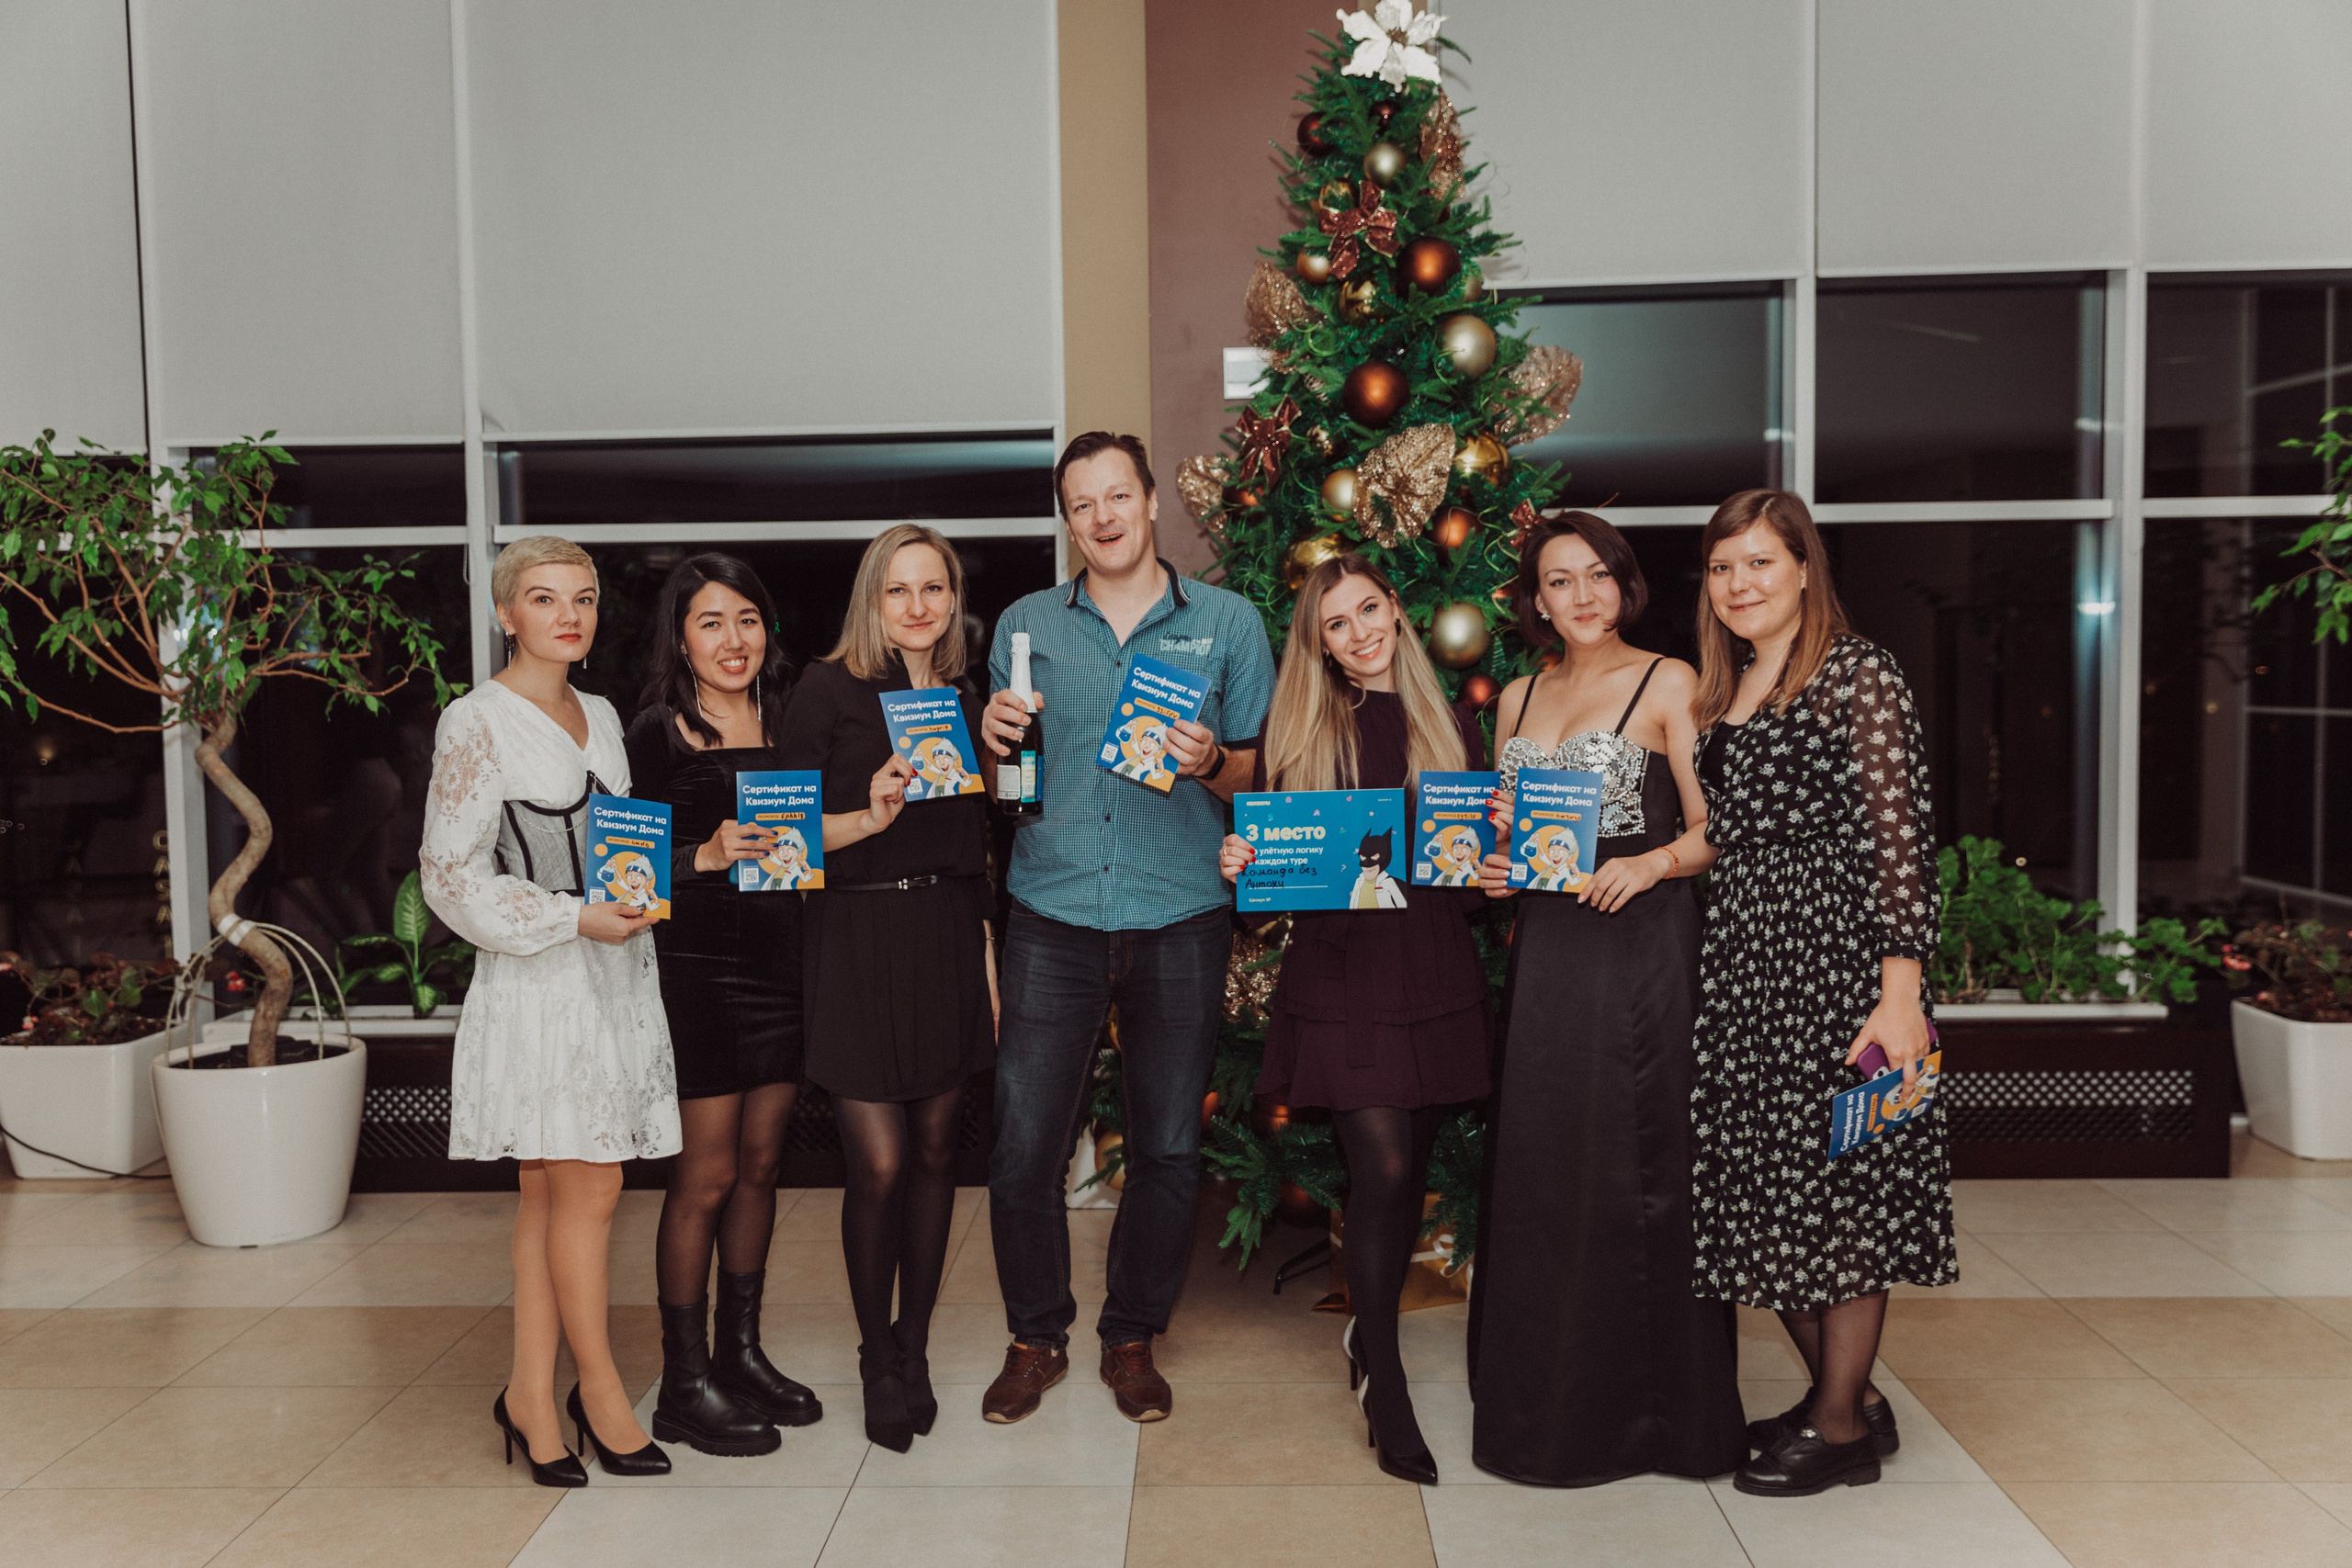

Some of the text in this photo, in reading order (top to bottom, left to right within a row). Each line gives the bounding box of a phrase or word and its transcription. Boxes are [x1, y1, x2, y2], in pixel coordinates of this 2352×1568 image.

[1133, 667, 1202, 699] Сертификат на
[1131, 678, 1194, 709] Квизиум Дома
[888, 700, 943, 712] Сертификат
[893, 710, 956, 723] Квизиум Дома
[742, 784, 802, 795] Сертификат
[1423, 784, 1481, 795] Сертификат
[1521, 780, 1582, 794] Сертификат
[745, 796, 814, 807] Квизиум Дома
[1425, 795, 1487, 807] Квизиум Дом
[1522, 793, 1593, 807] Квизиум Дома
[594, 807, 667, 825] Сертификат на
[596, 818, 664, 836] Квизиум Дома
[1246, 824, 1326, 841] 3 место
[1260, 847, 1295, 856] улётную
[1295, 847, 1323, 855] логику
[1255, 858, 1287, 866] каждом
[1840, 1093, 1854, 1152] Сертификат на
[1851, 1091, 1865, 1145] Квизиум Дома
